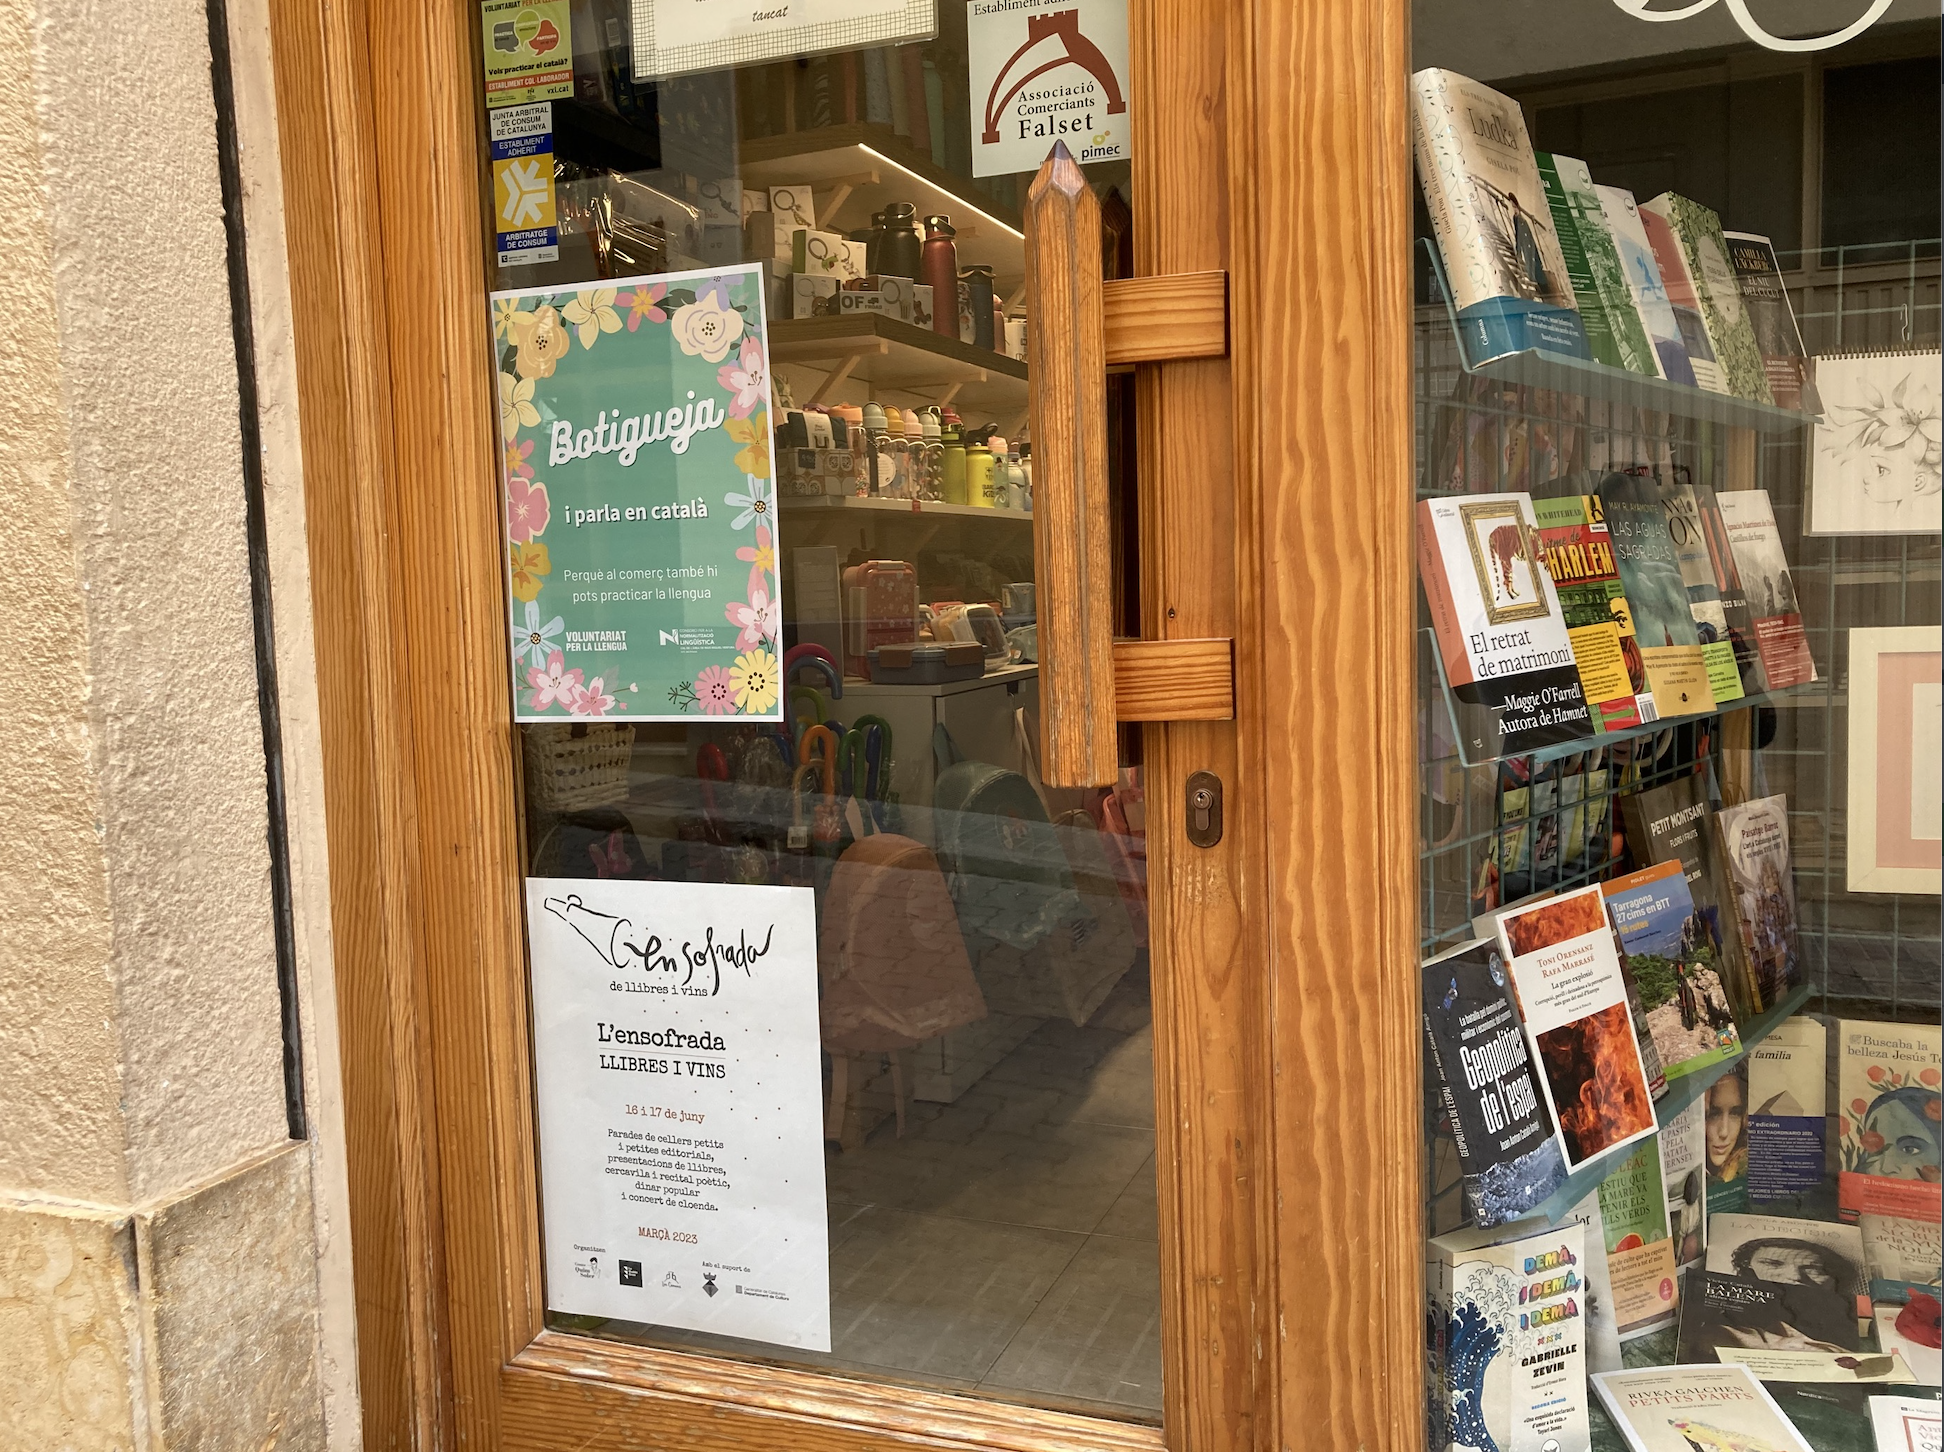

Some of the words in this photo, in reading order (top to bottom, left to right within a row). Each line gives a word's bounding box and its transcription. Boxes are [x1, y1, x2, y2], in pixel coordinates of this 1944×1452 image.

[484, 1, 520, 12] VOLUNTARIAT
[752, 6, 788, 22] tancat
[974, 0, 1041, 15] Establiment
[504, 63, 535, 74] practicar
[543, 58, 568, 68] català?
[489, 79, 524, 91] ESTABLIMENT
[1018, 81, 1095, 103] Associació
[492, 112, 514, 120] JUNTA
[515, 106, 549, 117] ARBITRAL
[1018, 97, 1095, 116] Comerciants
[507, 123, 547, 134] CATALUNYA
[511, 116, 541, 126] CONSUM
[1018, 113, 1094, 139] Falset
[1466, 107, 1519, 151] Ludka
[499, 136, 545, 149] ESTABLIMENT
[507, 145, 537, 156] ADHERIT
[1081, 144, 1121, 161] pimec
[505, 229, 548, 241] ARBITRATGE
[506, 241, 517, 249] DE
[517, 238, 547, 248] CONSUM
[1748, 276, 1758, 285] EL
[1743, 286, 1758, 297] DEL
[841, 296, 864, 308] OF
[549, 390, 725, 467] Botigueja
[565, 505, 571, 524] i
[574, 504, 621, 527] parla
[625, 508, 647, 521] en
[651, 496, 708, 519] català
[1544, 509, 1582, 520] WHITEHEAD
[1608, 501, 1620, 510] MAY
[1630, 503, 1659, 514] AYAMONTE
[1570, 528, 1580, 543] de
[1611, 521, 1633, 537] LAS
[1635, 522, 1667, 539] AGUAS
[1619, 544, 1672, 560] SAGRADAS
[1546, 542, 1616, 582] HARLEM
[564, 569, 604, 583] Perquè
[606, 567, 616, 580] al
[619, 568, 663, 582] comerç
[666, 565, 705, 579] també
[707, 565, 718, 577] hi
[573, 590, 598, 604] pots
[600, 588, 652, 603] practicar
[655, 587, 666, 600] la
[668, 587, 711, 602] llengua
[566, 631, 627, 642] VOLUNTARIAT
[1470, 631, 1489, 654] El
[1491, 628, 1532, 650] retrat
[566, 643, 581, 651] PER
[582, 642, 592, 651] LA
[594, 642, 628, 651] LLENGUA
[1477, 655, 1495, 678] de
[1497, 644, 1571, 675] matrimoni
[1541, 683, 1582, 704] O'Farrell
[1497, 712, 1539, 735] Autora
[1539, 709, 1553, 726] de
[1552, 704, 1588, 724] Hamnet
[1651, 816, 1670, 836] PETIT
[1670, 802, 1705, 828] MONTSANT
[1669, 835, 1683, 848] FLORS
[1684, 829, 1698, 842] FRUITS
[1613, 894, 1653, 913] Tarragona
[1616, 912, 1626, 923] 27
[1626, 908, 1646, 920] cims
[1646, 906, 1656, 914] en
[1655, 897, 1670, 911] BTT
[1551, 981, 1560, 990] La
[1560, 978, 1571, 988] gran
[1572, 970, 1594, 983] explosió
[610, 981, 623, 991] de
[625, 982, 669, 994] llibres
[671, 986, 678, 995] i
[681, 986, 708, 997] vins
[1458, 1016, 1466, 1027] La
[1465, 1009, 1481, 1024] batalla
[597, 1023, 727, 1051] L'ensofrada
[1461, 1028, 1476, 1041] militar
[1863, 1035, 1914, 1050] Buscaba
[1917, 1040, 1928, 1051] la
[1460, 1026, 1528, 1091] Geopolítica
[1754, 1050, 1792, 1061] familia
[1848, 1046, 1888, 1059] belleza
[1892, 1050, 1926, 1063] Jesús
[600, 1055, 669, 1074] LLIBRES
[673, 1061, 682, 1075] I
[686, 1062, 726, 1079] VINS
[1480, 1089, 1504, 1134] de
[1495, 1067, 1538, 1126] l'espai
[625, 1104, 638, 1115] 16
[641, 1106, 648, 1117] i
[650, 1107, 662, 1117] 17
[665, 1109, 677, 1119] de
[679, 1110, 705, 1124] juny
[608, 1129, 643, 1140] Parades
[645, 1133, 655, 1142] de
[658, 1135, 692, 1146] cellers
[694, 1139, 724, 1149] petits
[1450, 1118, 1469, 1157] GEOPOLÍTICA
[1668, 1123, 1691, 1139] PASTÍS
[1666, 1136, 1684, 1149] PELA
[618, 1142, 624, 1151] i
[626, 1144, 659, 1154] petites
[661, 1147, 715, 1162] editorials,
[608, 1154, 673, 1169] presentacions
[675, 1161, 685, 1170] de
[687, 1162, 727, 1176] llibres,
[605, 1167, 650, 1179] cercavila
[652, 1171, 658, 1180] i
[660, 1173, 694, 1184] recital
[696, 1176, 731, 1189] poètic,
[1630, 1172, 1648, 1186] QUE
[635, 1181, 661, 1192] dinar
[663, 1185, 700, 1197] popular
[1608, 1187, 1635, 1200] MARE
[1636, 1184, 1648, 1193] VA
[621, 1192, 627, 1200] i
[629, 1193, 663, 1205] concert
[666, 1197, 676, 1206] de
[678, 1199, 719, 1211] cloenda.
[1600, 1200, 1628, 1214] TENIR
[1631, 1195, 1646, 1207] ELS
[1622, 1205, 1651, 1220] VERDS
[638, 1227, 670, 1241] MARÇÀ
[672, 1232, 698, 1244] 2023
[1730, 1222, 1755, 1230] LA
[1763, 1224, 1841, 1239] DECISIÓ
[722, 1264, 742, 1272] suport
[1524, 1244, 1577, 1276] DEMÀ,
[1519, 1286, 1527, 1305] I
[1529, 1270, 1581, 1302] DEMÀ,
[1706, 1282, 1726, 1291] LA
[1731, 1286, 1775, 1299] MARE
[1706, 1288, 1767, 1304] BALENA
[1520, 1313, 1529, 1331] I
[1530, 1297, 1579, 1328] DEMÀ
[1521, 1344, 1577, 1367] GABRIELLE
[1533, 1361, 1565, 1378] ZEVIN
[1628, 1389, 1673, 1400] RIVKA
[1675, 1386, 1744, 1396] GALCHEN
[1628, 1394, 1693, 1408] PETITS
[1699, 1392, 1754, 1402] PARTS
[1554, 1406, 1575, 1416] declaració
